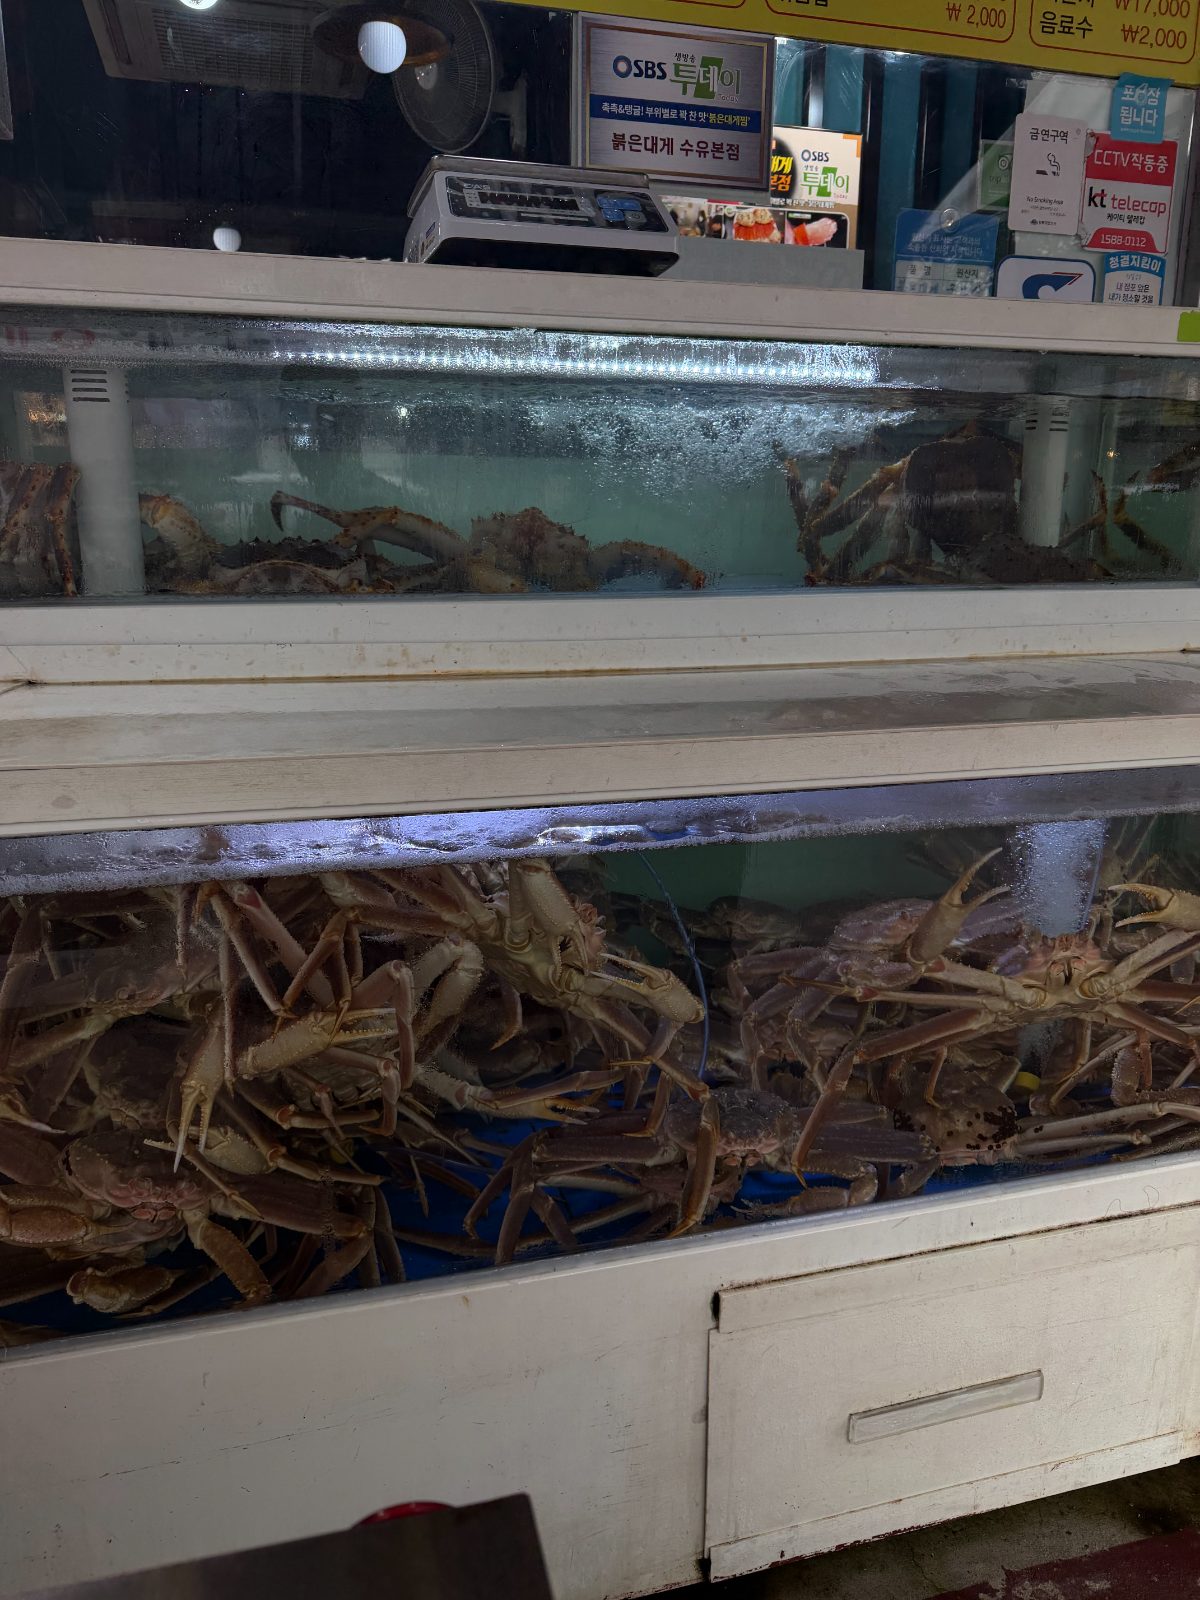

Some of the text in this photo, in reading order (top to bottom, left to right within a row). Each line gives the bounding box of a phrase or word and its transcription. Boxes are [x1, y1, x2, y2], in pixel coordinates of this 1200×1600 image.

[1039, 10, 1187, 49] 음료수 ₩2,000
[674, 52, 696, 63] 생방송
[632, 59, 667, 80] SBS
[669, 60, 741, 96] 투데이
[1121, 83, 1161, 106] 포장
[646, 107, 678, 119] 부위별로
[689, 111, 697, 121] 찬
[1120, 105, 1159, 127] 됩니다
[611, 132, 740, 161] 붉은대게 수유본점
[1029, 127, 1069, 145] 금연구역
[811, 151, 829, 162] SBS
[1093, 149, 1169, 174] CCTV작동중
[800, 171, 849, 196] 투데이
[1087, 186, 1167, 218] kt telecop
[1106, 212, 1126, 223] 케이티
[1100, 233, 1147, 248] 1588-0112
[1109, 254, 1162, 273] 청결지킴이
[1124, 282, 1136, 292] 점포
